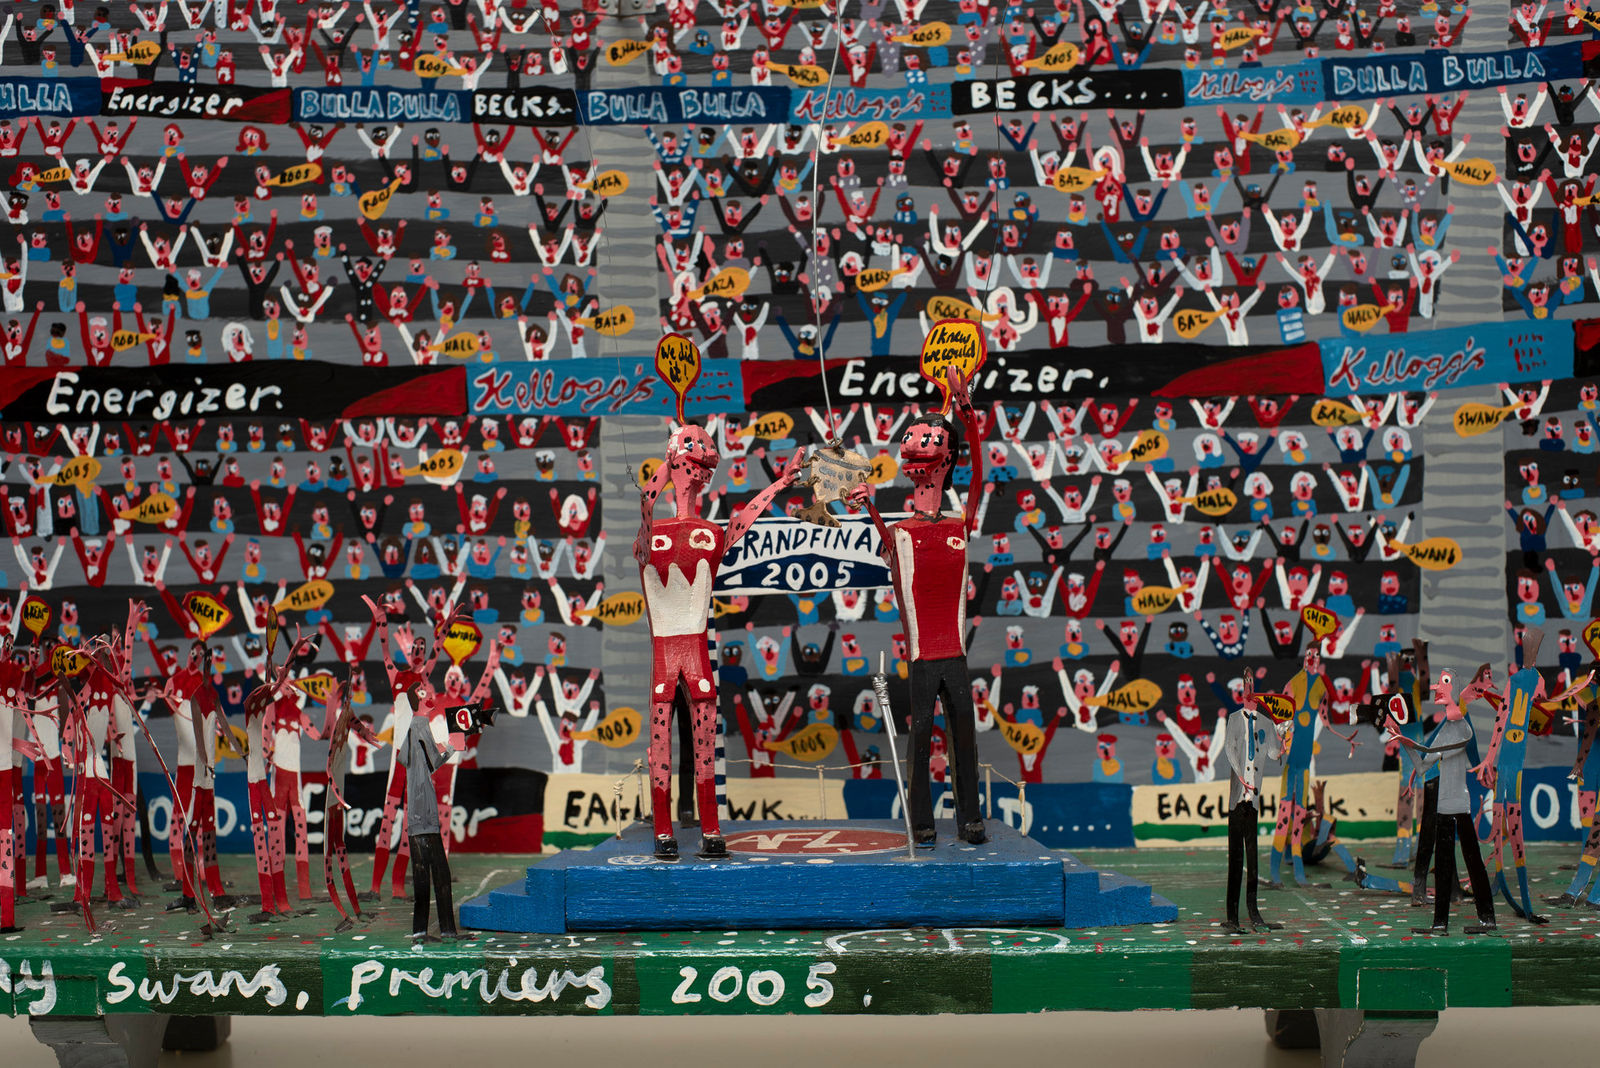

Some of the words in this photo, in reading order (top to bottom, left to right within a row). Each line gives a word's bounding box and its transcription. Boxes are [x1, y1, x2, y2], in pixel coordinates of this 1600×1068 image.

[912, 29, 942, 43] ROOS
[419, 60, 448, 75] ROOS
[1334, 62, 1428, 95] BULLA
[1442, 52, 1546, 86] BULLA
[1188, 69, 1296, 101] Kellogg's
[108, 86, 245, 116] Energizer
[300, 90, 386, 119] BULLA
[387, 91, 463, 122] BULLA
[588, 92, 669, 122] BULLA
[679, 90, 766, 119] BULLA
[796, 89, 926, 122] Kellogg's
[1330, 112, 1362, 127] ROOS
[849, 130, 881, 144] ROOS
[279, 168, 310, 184] ROOS
[1058, 175, 1084, 187] BAZ
[702, 277, 735, 295] BAZA
[1178, 312, 1209, 332] BAZ
[444, 337, 474, 353] HALL
[937, 326, 972, 345] knew
[678, 341, 695, 367] did
[924, 348, 941, 364] we
[942, 339, 976, 361] could
[1328, 338, 1488, 390] Kellogg's
[46, 371, 283, 420] Energizer.
[473, 362, 660, 413] Kellogg's
[1317, 405, 1347, 425] BAZ
[1458, 410, 1503, 427] SWANS
[754, 418, 788, 437] BAZA
[1130, 436, 1161, 459] ROOS
[419, 456, 454, 471] ROOS
[139, 501, 170, 518] HALL
[1197, 492, 1233, 509] HALL
[760, 560, 856, 592] 2005
[290, 586, 327, 606] HALL
[1137, 593, 1172, 611] HALL
[598, 598, 644, 617] SWANS
[1303, 609, 1328, 628] SHIT
[1106, 688, 1151, 709] HALL
[1391, 697, 1408, 721] 9
[597, 716, 633, 742] ROOS
[1005, 722, 1041, 754] ROOS
[790, 731, 826, 756] ROOS
[726, 831, 878, 850] AFL
[348, 959, 612, 1011] Premiers
